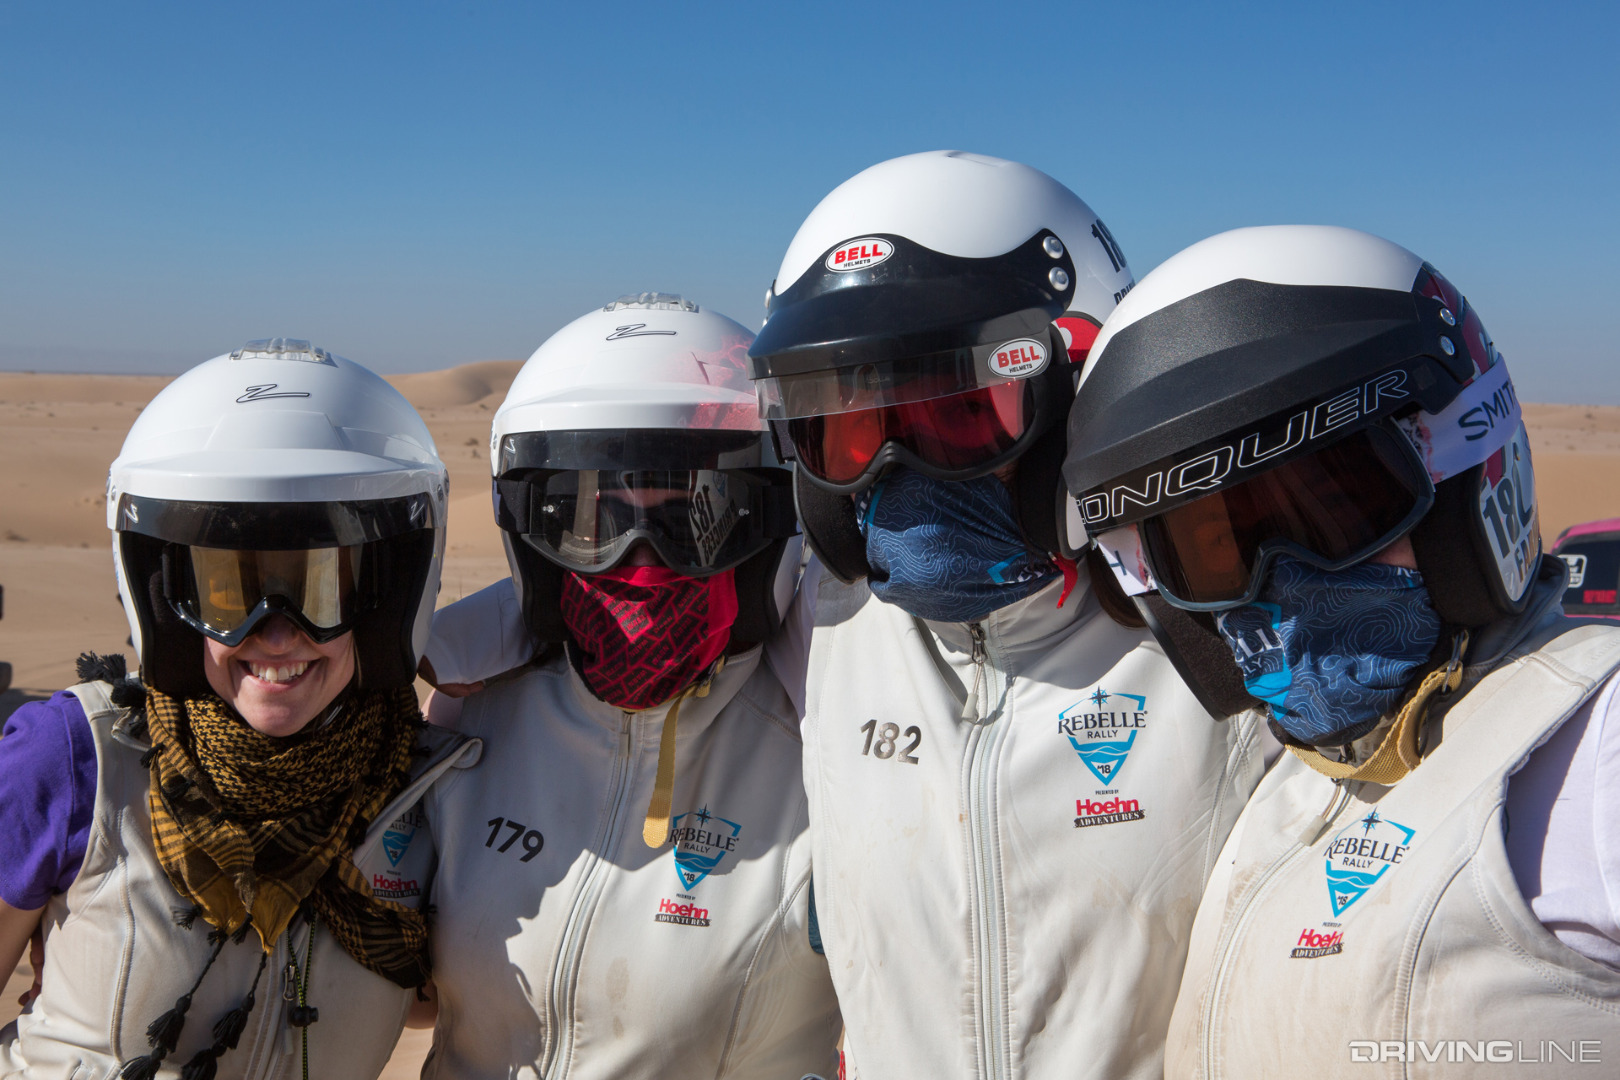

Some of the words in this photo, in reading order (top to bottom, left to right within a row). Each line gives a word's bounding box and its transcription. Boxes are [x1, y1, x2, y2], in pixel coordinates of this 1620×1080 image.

[834, 244, 884, 264] BELL
[843, 258, 871, 268] HELMETS
[997, 345, 1040, 368] BELL
[1009, 363, 1033, 373] HELMETS
[1458, 381, 1516, 441] SMIT
[1076, 369, 1410, 525] ONQUER
[1057, 711, 1147, 737] REBELLE
[1087, 729, 1118, 739] RALLY
[860, 718, 922, 766] 182
[1076, 797, 1139, 817] Hoehn
[1079, 810, 1140, 826] ADVENTURES
[485, 816, 545, 863] 179
[668, 827, 735, 852] REBELLE
[684, 842, 711, 854] RALLY
[1323, 837, 1405, 864] REBELLE
[1342, 856, 1374, 868] RALLY
[373, 873, 418, 891] Hoehn
[659, 898, 709, 920] Hoehn
[659, 914, 706, 927] ADVENTURES
